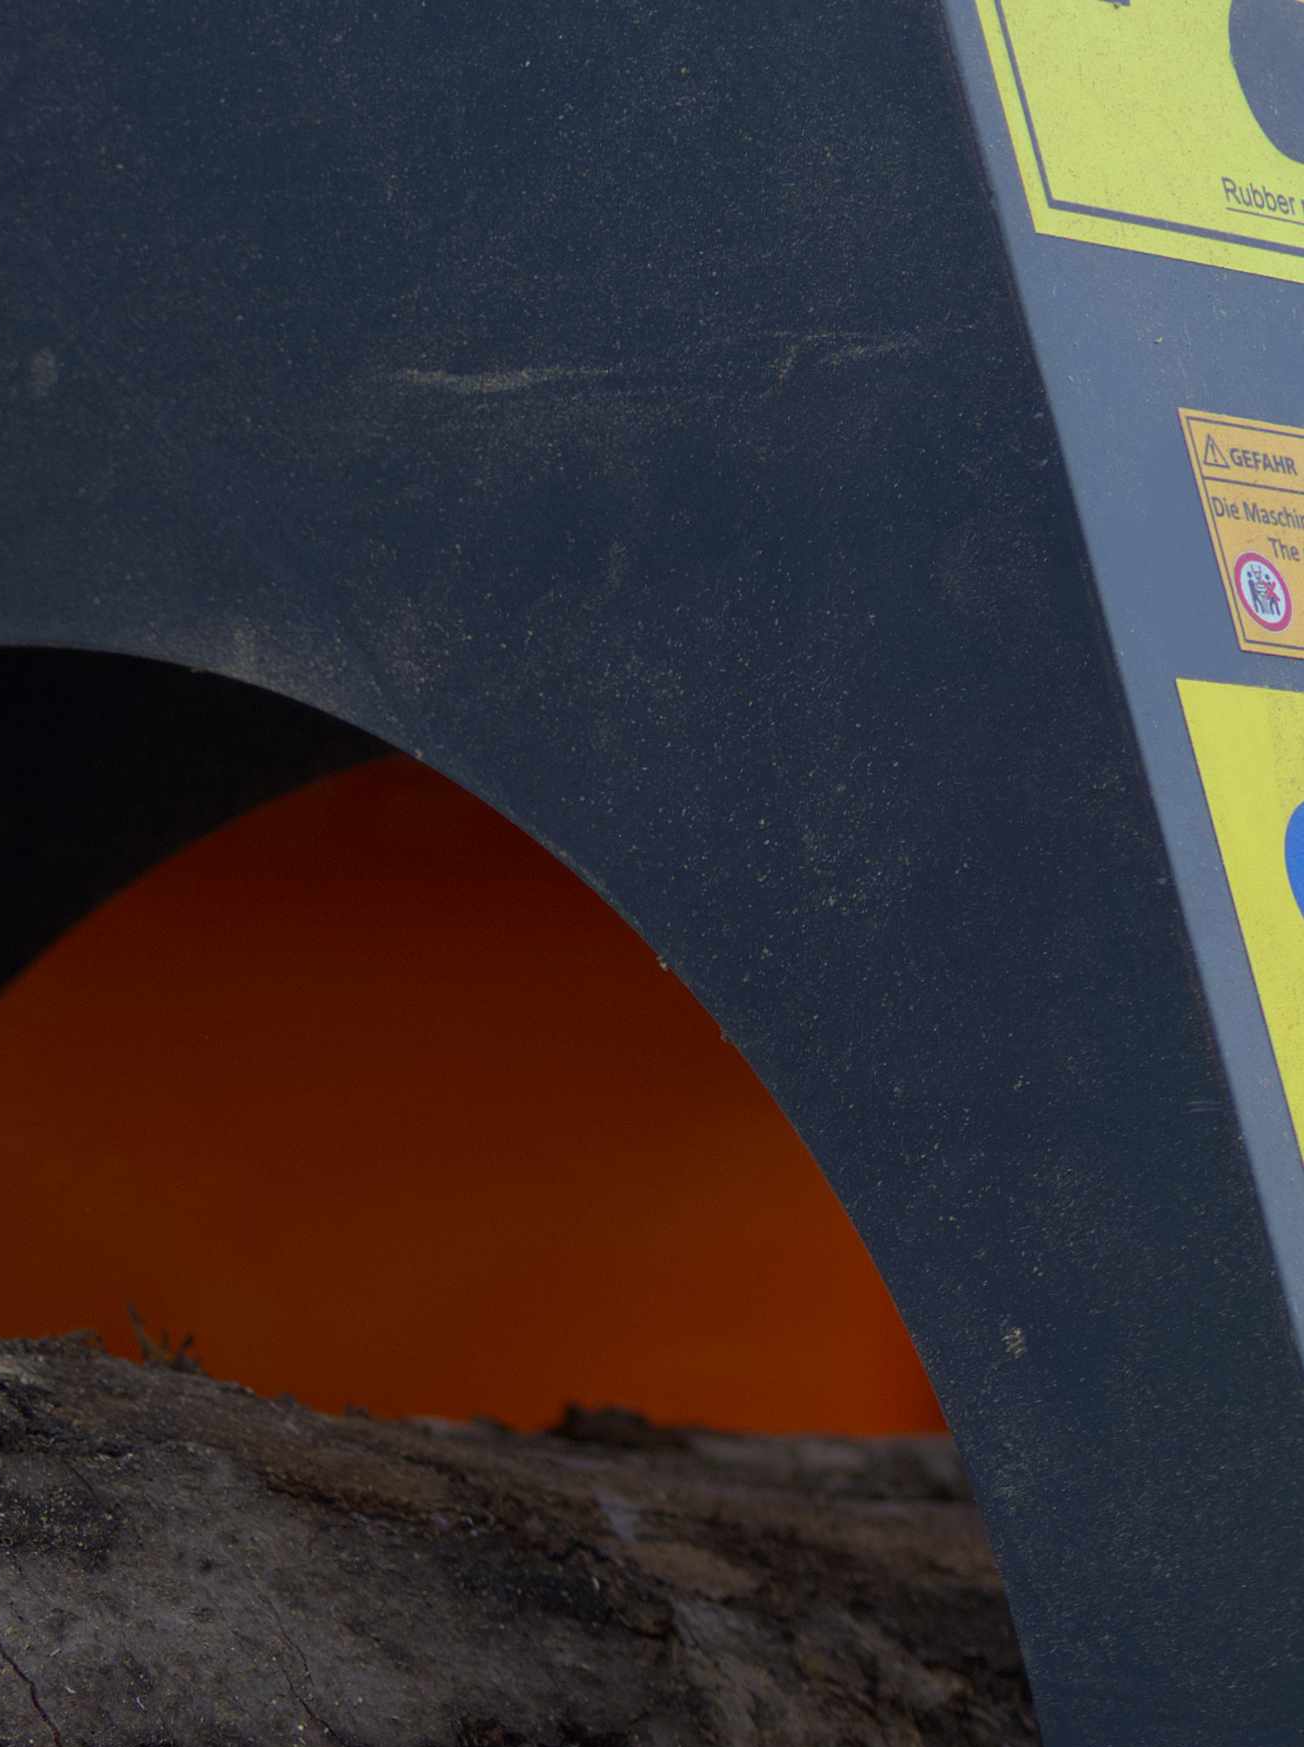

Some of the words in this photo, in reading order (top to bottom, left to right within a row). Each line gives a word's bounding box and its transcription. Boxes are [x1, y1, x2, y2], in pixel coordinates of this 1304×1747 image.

[1221, 176, 1296, 216] Rubber
[1229, 447, 1298, 476] GEFAHR
[1210, 496, 1241, 520] Die
[1267, 536, 1301, 562] The
